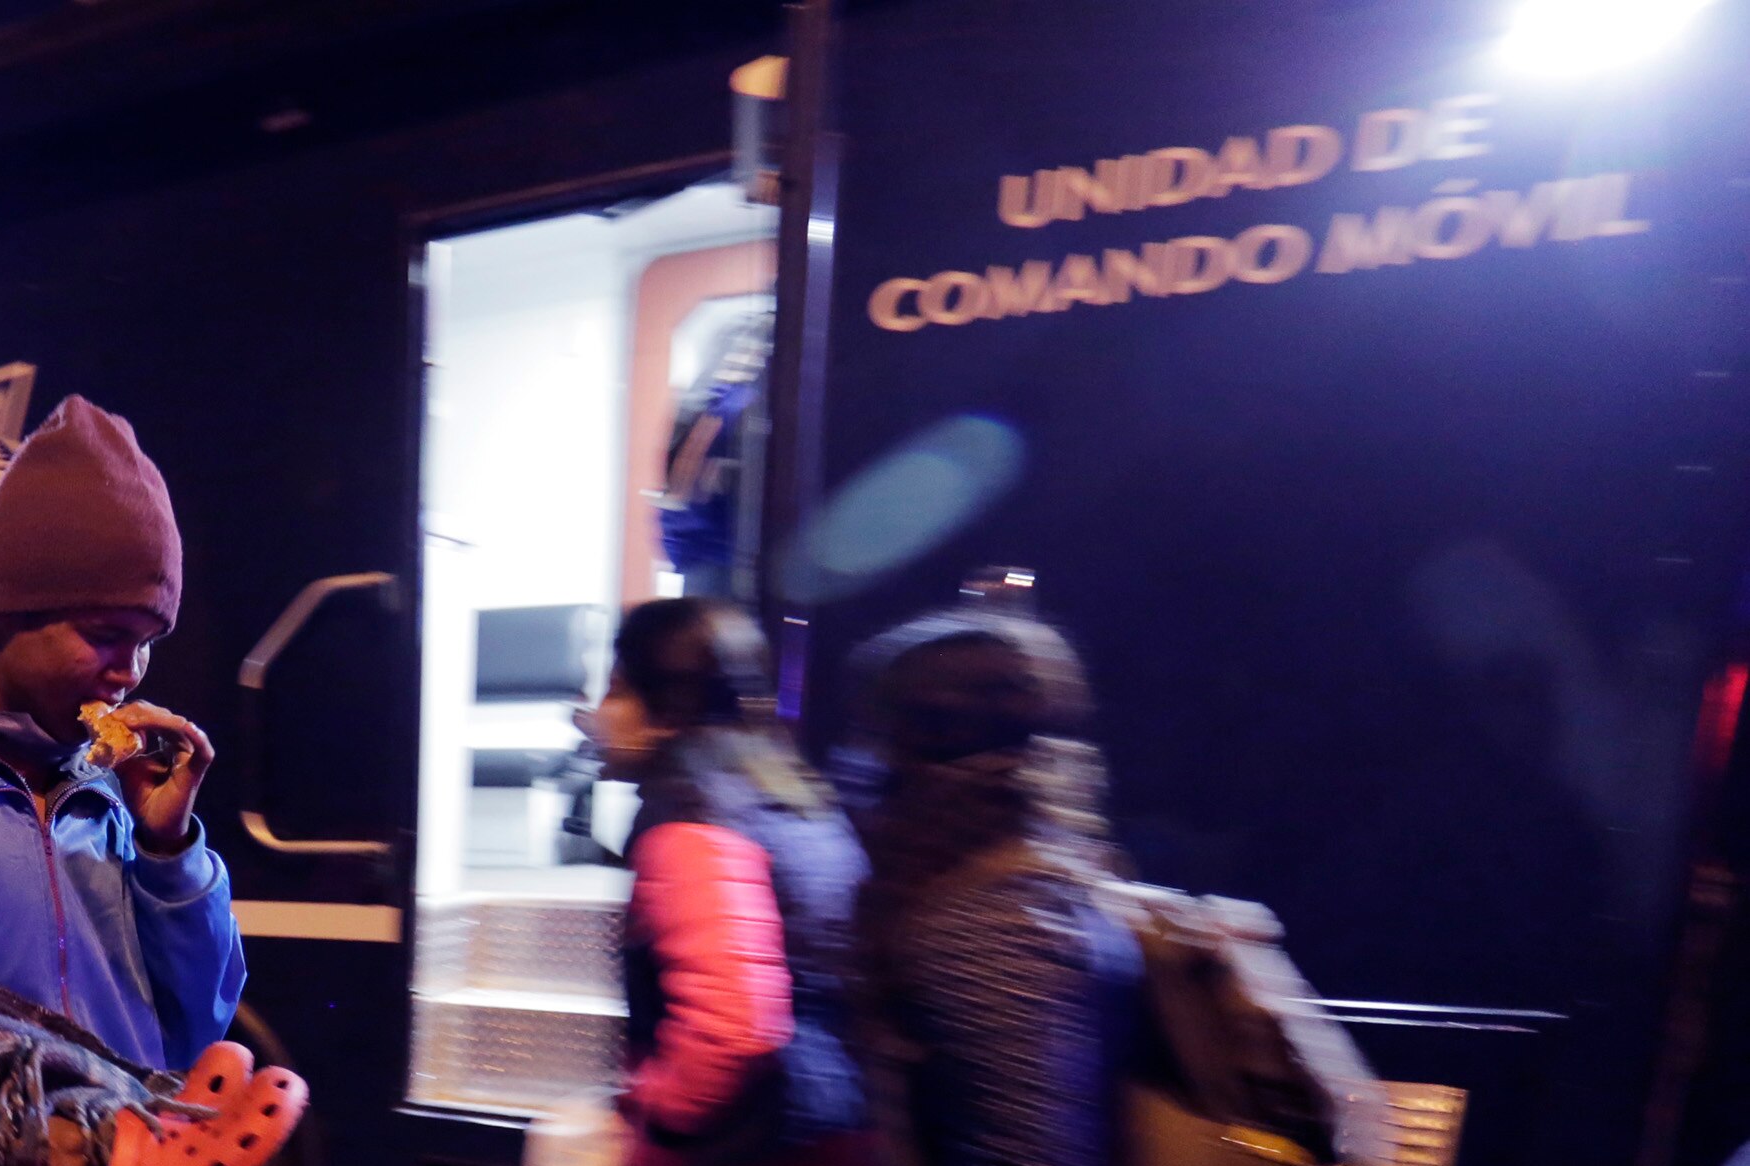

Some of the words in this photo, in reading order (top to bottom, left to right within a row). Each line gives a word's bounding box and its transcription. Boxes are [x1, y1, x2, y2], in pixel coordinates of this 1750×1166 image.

[998, 125, 1340, 228] UNIDAD
[1351, 95, 1493, 172] DE
[868, 224, 1312, 332] COMANDO
[1315, 173, 1650, 273] MÓVIL
